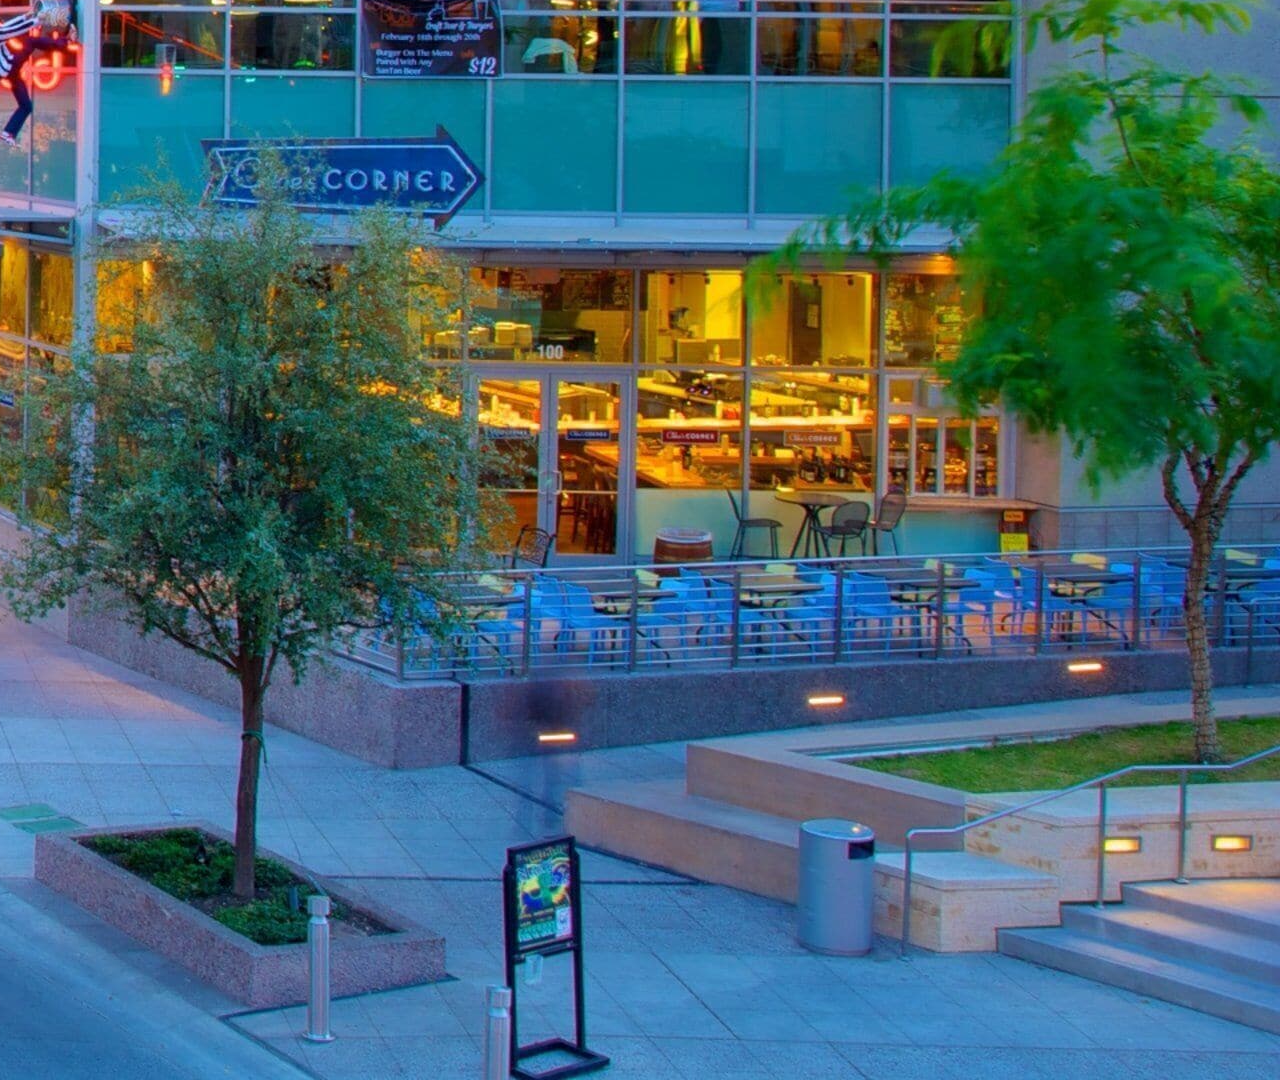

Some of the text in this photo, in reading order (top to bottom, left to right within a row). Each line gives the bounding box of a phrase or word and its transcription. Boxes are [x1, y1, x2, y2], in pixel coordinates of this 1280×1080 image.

[381, 33, 415, 42] February
[434, 33, 462, 42] through
[376, 49, 453, 59] Burger On The Menu
[376, 58, 433, 68] Paired With Any
[469, 56, 497, 75] $12
[404, 67, 422, 75] Beer
[322, 168, 456, 193] CORNER
[537, 344, 564, 360] 100
